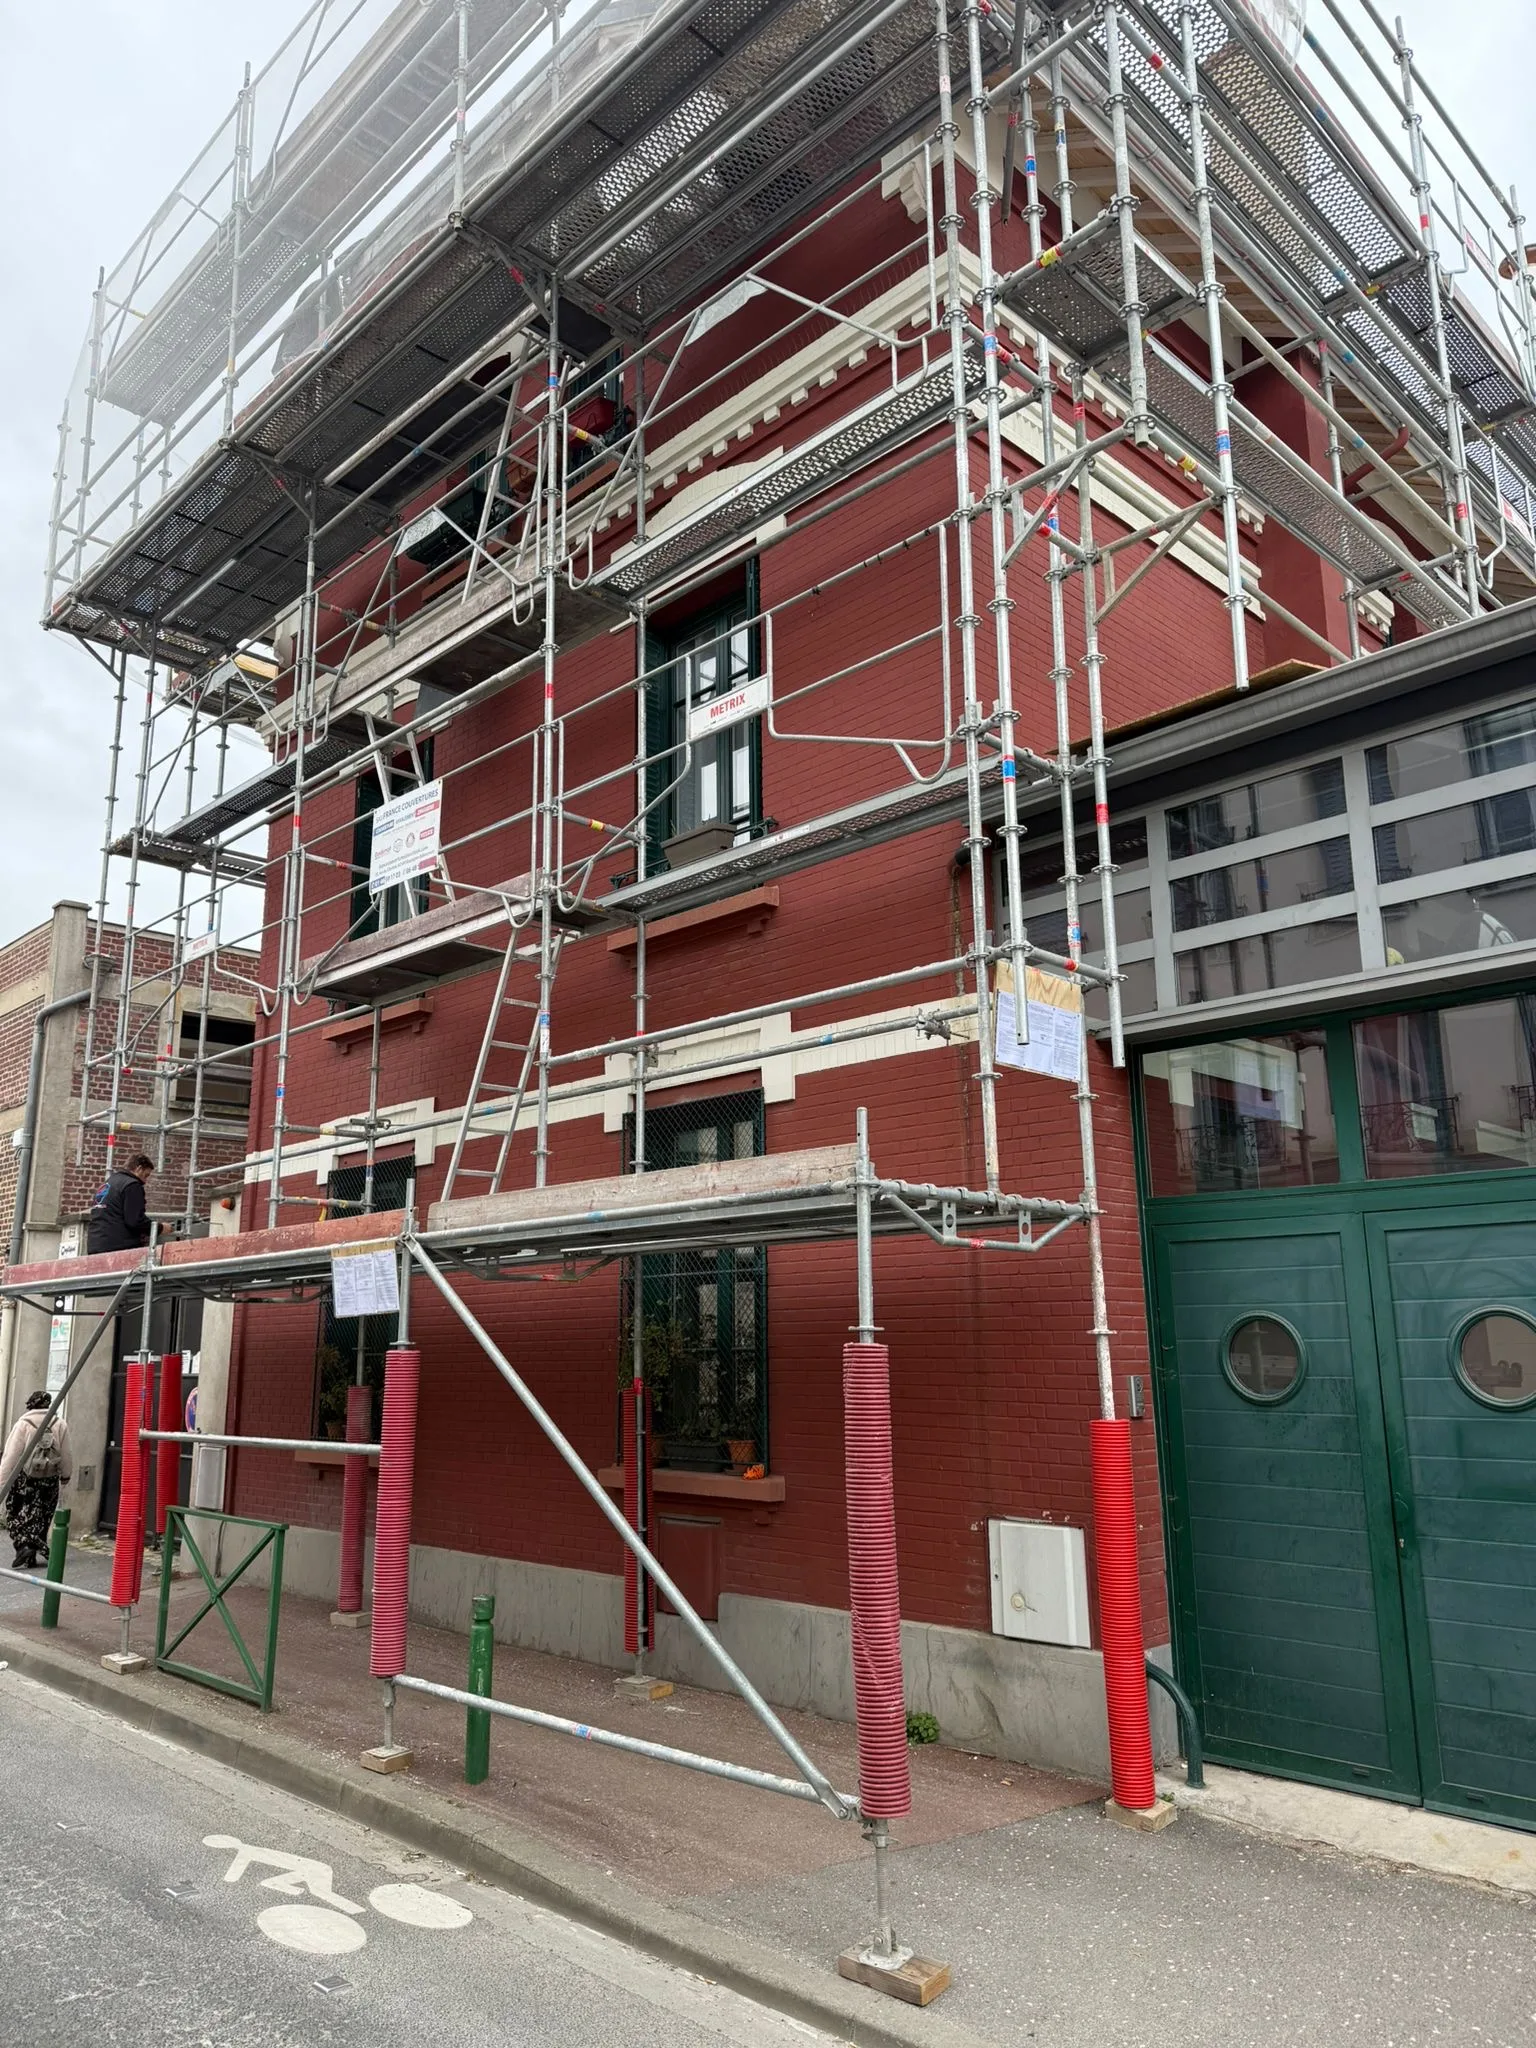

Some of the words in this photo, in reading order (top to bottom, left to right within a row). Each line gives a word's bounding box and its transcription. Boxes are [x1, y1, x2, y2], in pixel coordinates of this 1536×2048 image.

[710, 693, 746, 718] METRIX
[383, 805, 401, 819] FRANCE
[401, 788, 438, 811] COUVERTURES
